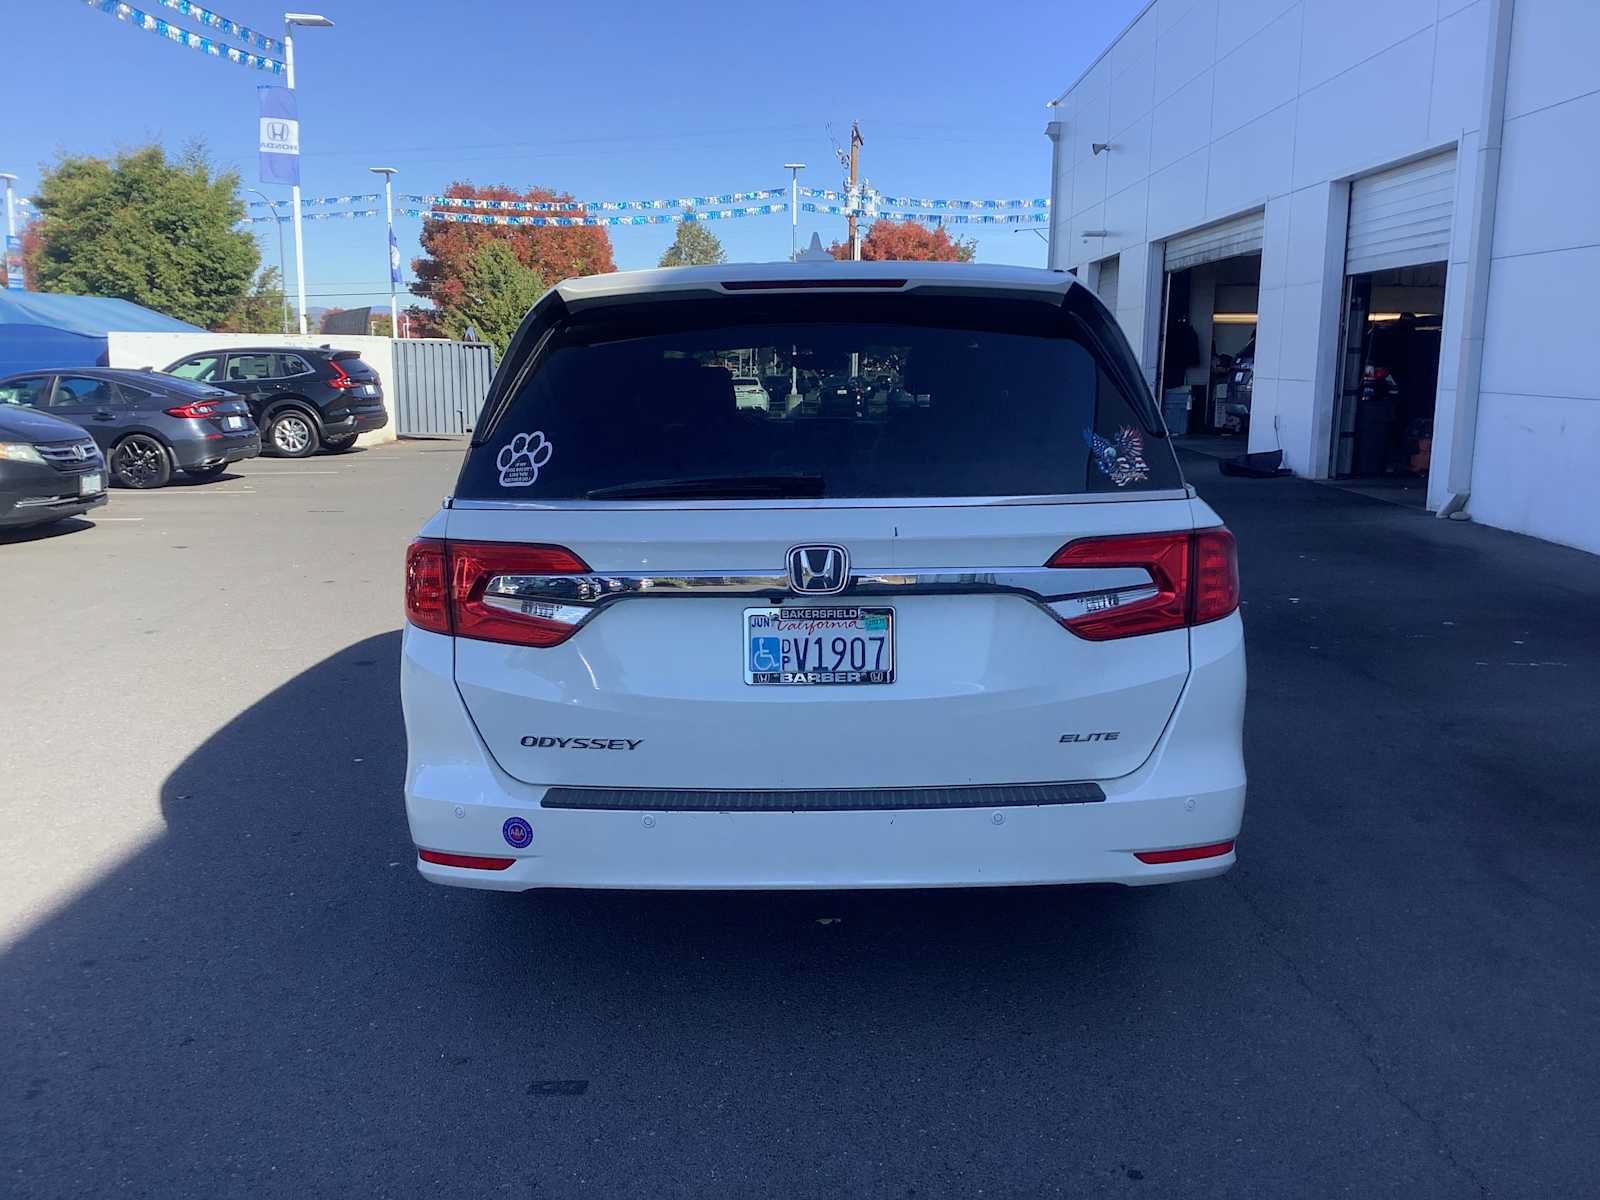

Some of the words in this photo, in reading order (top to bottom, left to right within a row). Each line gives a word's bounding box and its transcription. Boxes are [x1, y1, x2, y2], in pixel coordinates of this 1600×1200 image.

[781, 609, 857, 619] BAKERSFIELD
[751, 616, 770, 628] JUN
[793, 637, 885, 672] V1907
[780, 672, 861, 683] BARBER
[1059, 731, 1121, 743] ELITE
[520, 736, 645, 751] ODYSSEY
